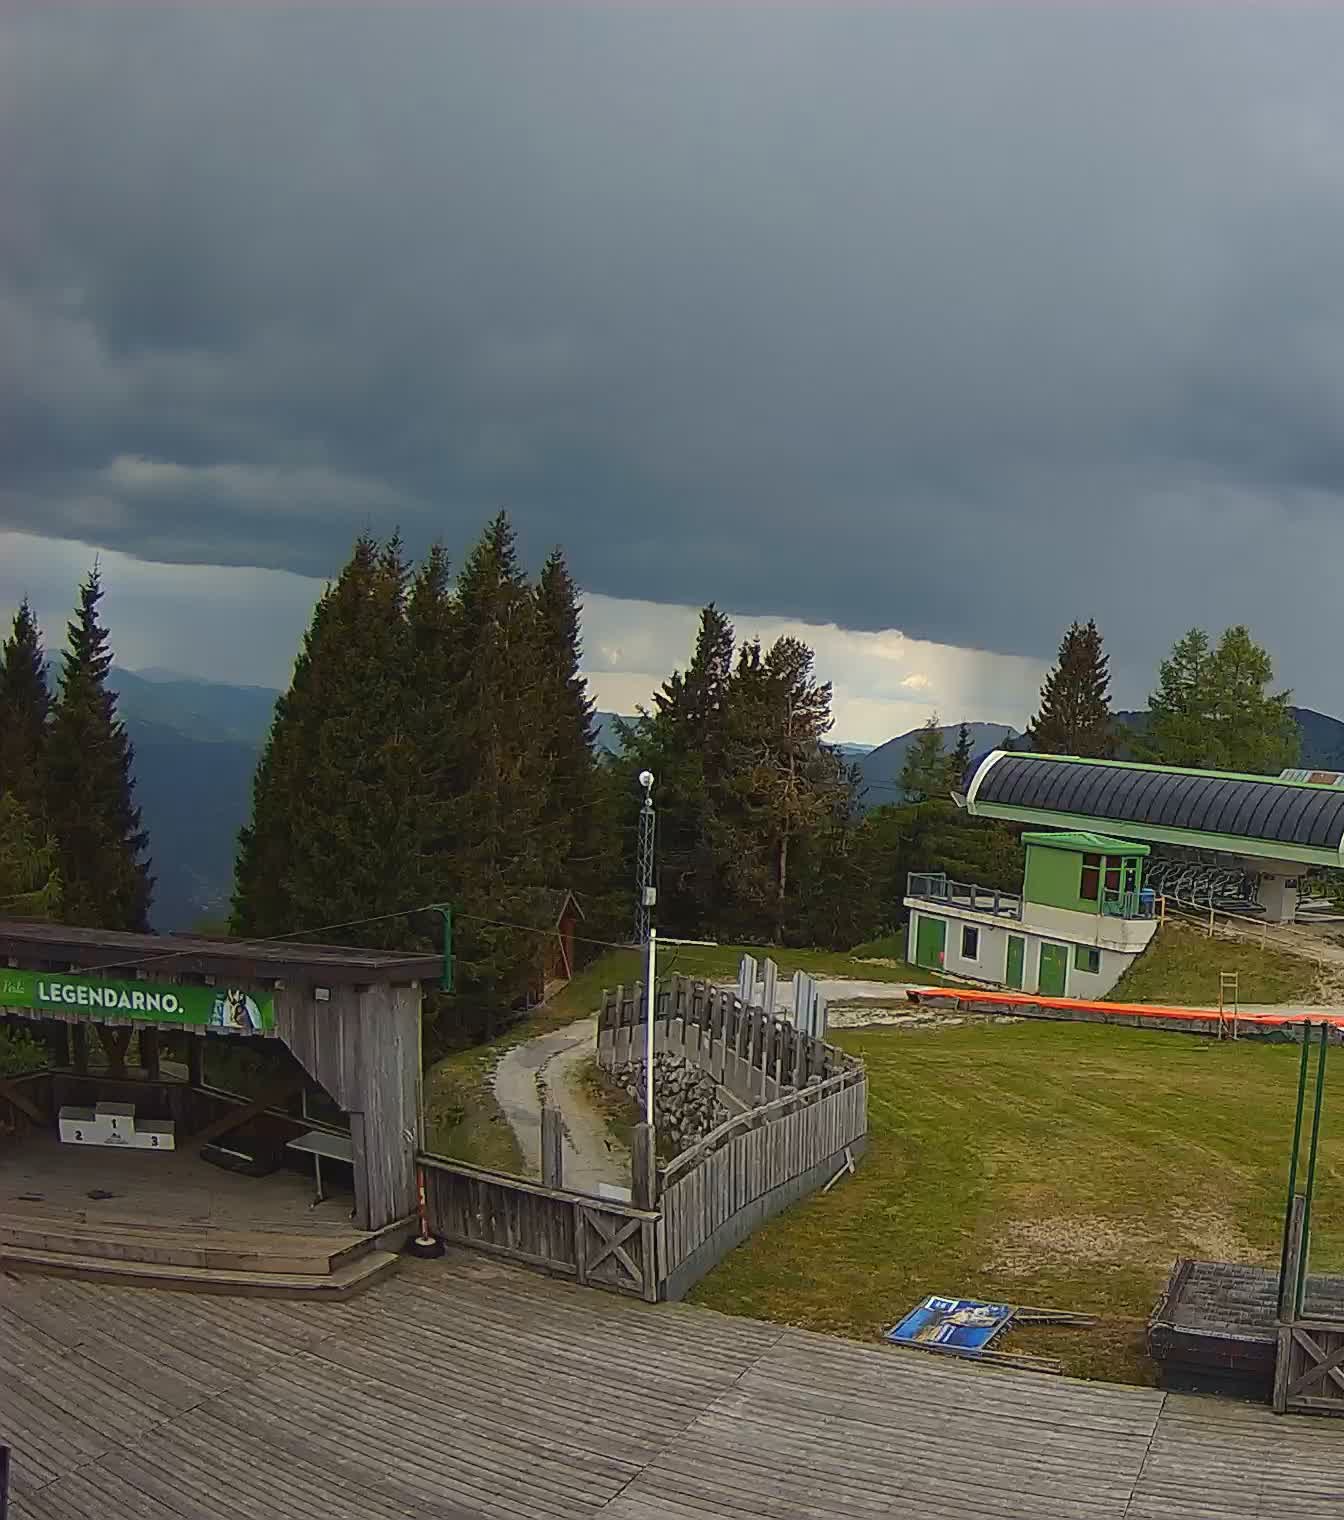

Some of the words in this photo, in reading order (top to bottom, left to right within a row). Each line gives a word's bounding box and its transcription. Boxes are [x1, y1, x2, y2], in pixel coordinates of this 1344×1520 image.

[38, 981, 184, 1013] LEGENDARNO.
[75, 1130, 83, 1141] 2
[151, 1136, 159, 1147] 3
